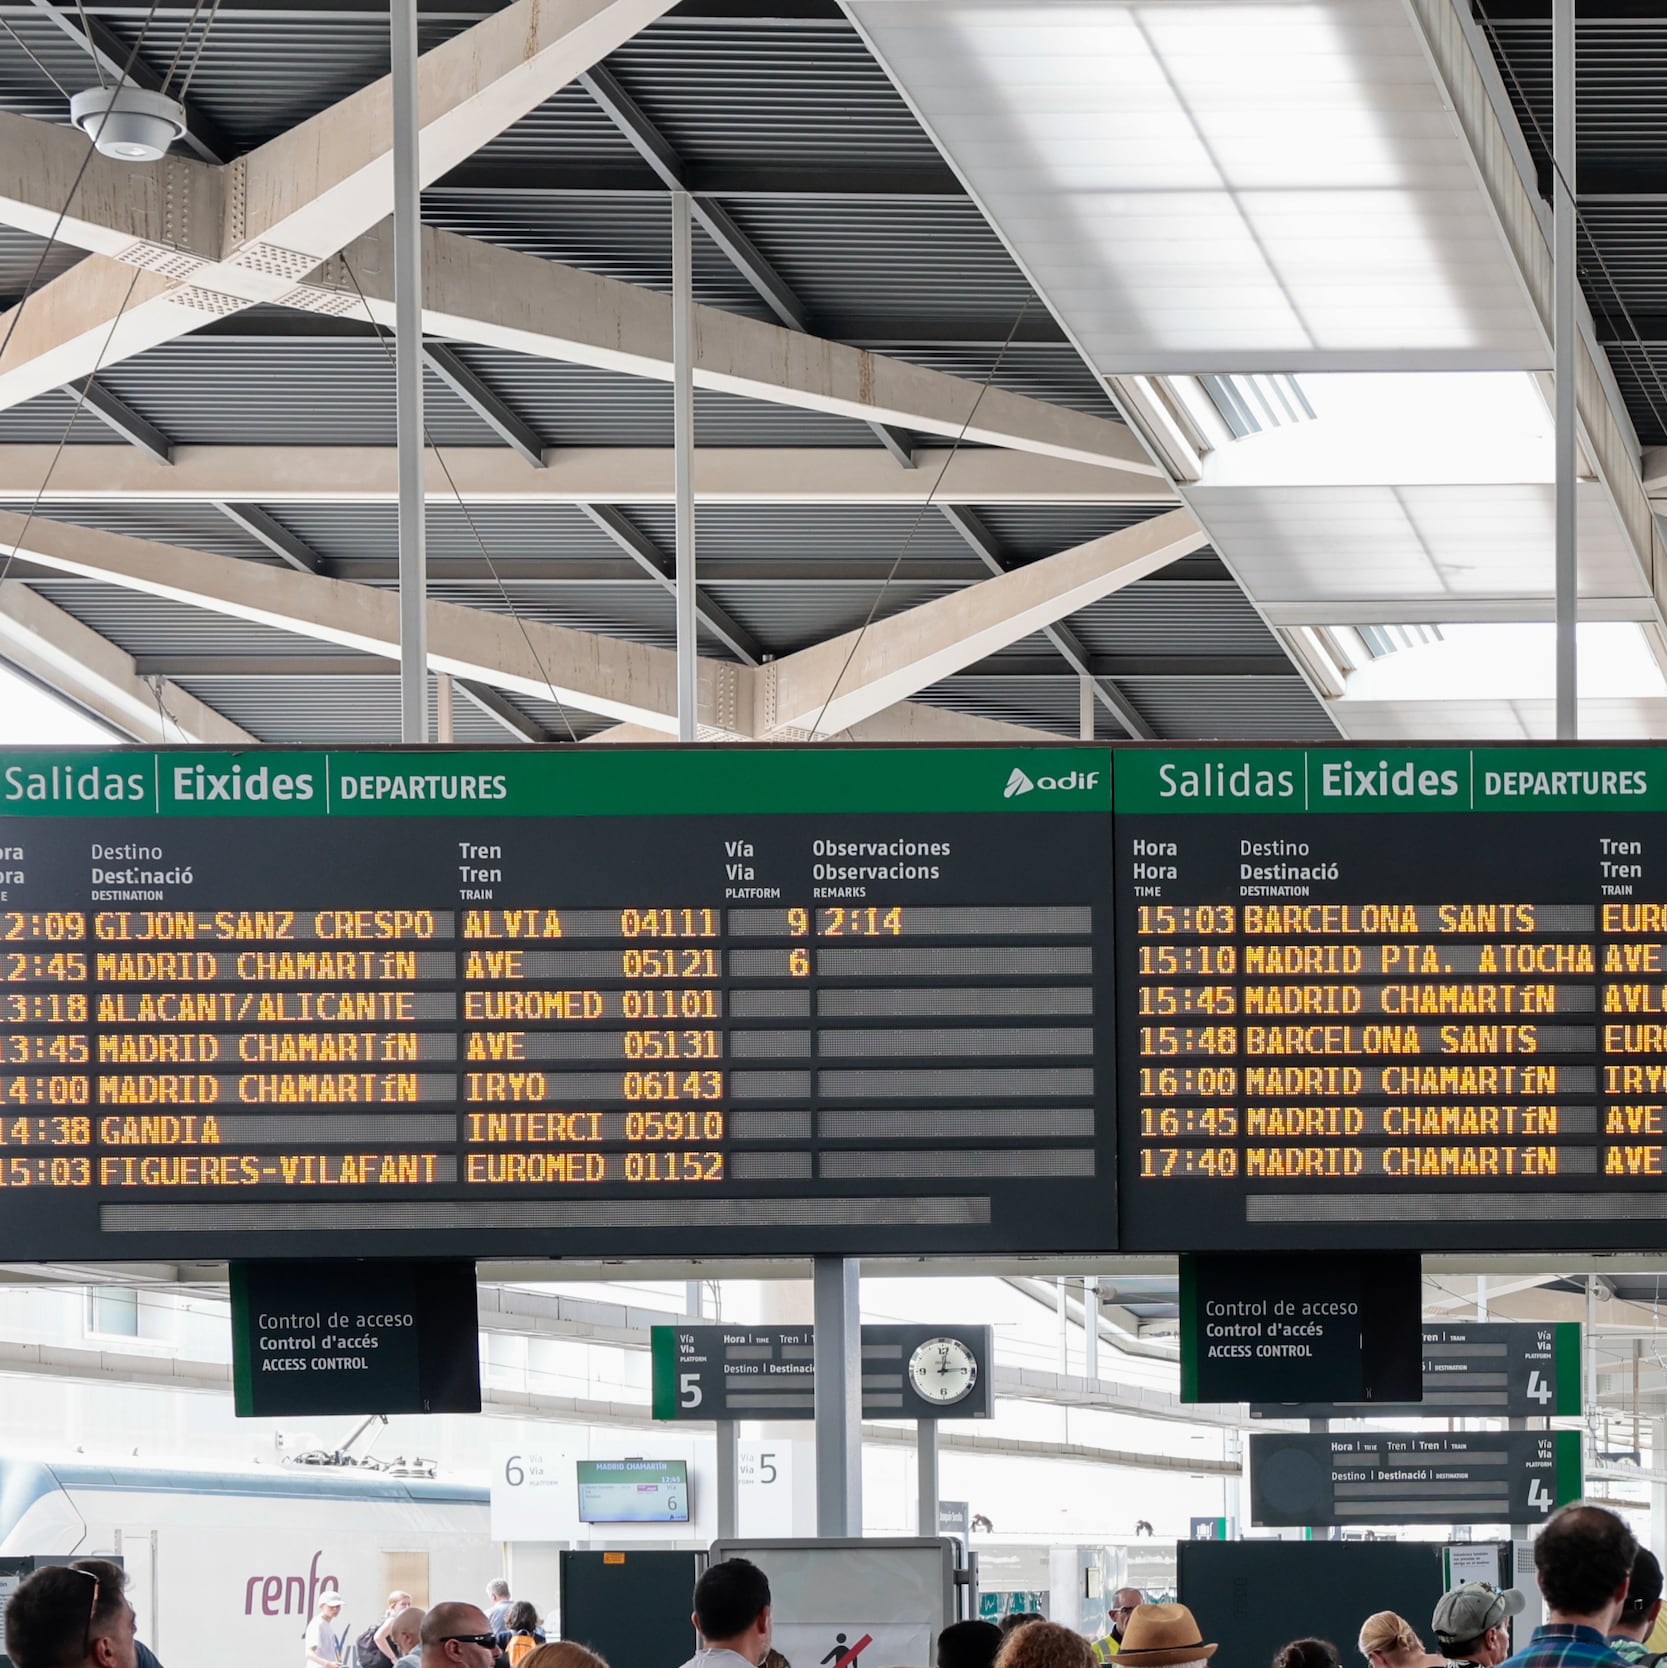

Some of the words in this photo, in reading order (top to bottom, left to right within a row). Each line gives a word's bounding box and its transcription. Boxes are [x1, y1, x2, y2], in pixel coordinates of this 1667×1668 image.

[5, 766, 144, 800] Salidas
[174, 764, 313, 800] Eixides
[341, 775, 507, 799] DEPARTURES
[1037, 771, 1099, 790] adif
[1159, 763, 1293, 797] Salidas
[1323, 760, 1458, 796] Eixides
[1485, 771, 1647, 795] DEPARTURES
[1133, 839, 1177, 856] Hora
[1241, 840, 1309, 856] Destino
[1600, 839, 1641, 855] Tren
[1134, 863, 1177, 879] Hora
[1241, 862, 1339, 880] Destinació
[1600, 861, 1641, 878] Tren
[1134, 886, 1161, 897] TIME
[1240, 886, 1309, 896] DESTINATION
[1601, 885, 1632, 895] TRAIN
[95, 911, 295, 940] GIJON-SANZ
[315, 911, 435, 939] CRESPO
[464, 909, 563, 938] ALVIA
[621, 908, 713, 938] 04111
[788, 908, 808, 934] 9
[1139, 906, 1236, 934] 15:03
[1244, 905, 1420, 934] BARCELONA
[1439, 904, 1536, 933] SANTS
[1138, 946, 1235, 974] 15:10
[1245, 945, 1363, 974] MADRID
[1381, 944, 1452, 974] PTA.
[1478, 944, 1595, 974] ATOCHA
[1604, 944, 1660, 973] AVE
[97, 992, 412, 1022] ALACANT/ALICANTE
[464, 990, 604, 1021] EUROMED
[623, 989, 714, 1018] 01101
[101, 1116, 221, 1144] GANDIA
[470, 1112, 601, 1142] INTERCI
[625, 1111, 724, 1141] 05910
[258, 1311, 320, 1330] Control
[327, 1311, 349, 1330] de
[356, 1314, 413, 1327] acceso
[260, 1335, 316, 1350] Control
[322, 1333, 378, 1349] d'accés
[680, 1334, 694, 1343] Vía
[724, 1335, 745, 1343] Hora
[779, 1335, 799, 1343] Tren
[680, 1344, 695, 1353] Via
[262, 1358, 307, 1371] ACCESS
[311, 1357, 368, 1370] CONTROL
[724, 1364, 758, 1373] Destino
[680, 1373, 702, 1408] 5
[505, 1456, 524, 1486] 6
[1378, 1470, 1426, 1480] Destinació
[1528, 1479, 1553, 1512] 4
